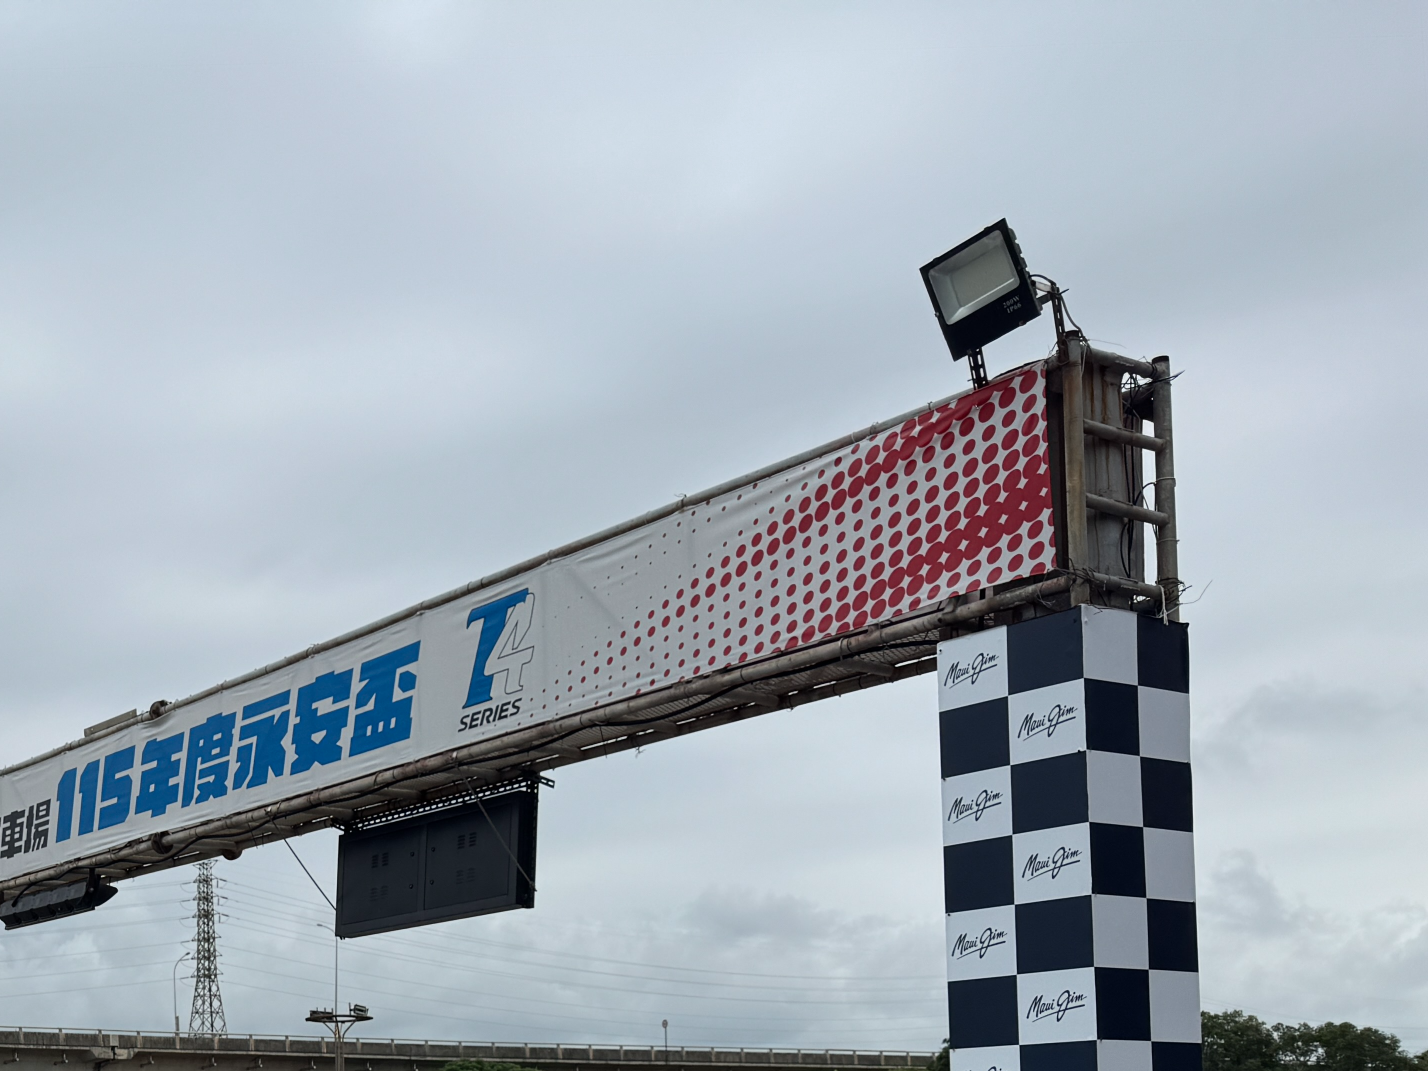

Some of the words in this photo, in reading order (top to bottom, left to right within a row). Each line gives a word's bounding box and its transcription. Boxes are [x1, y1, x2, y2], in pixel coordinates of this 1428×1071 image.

[55, 640, 421, 843] 115年度永安盃
[457, 697, 522, 733] SERIES
